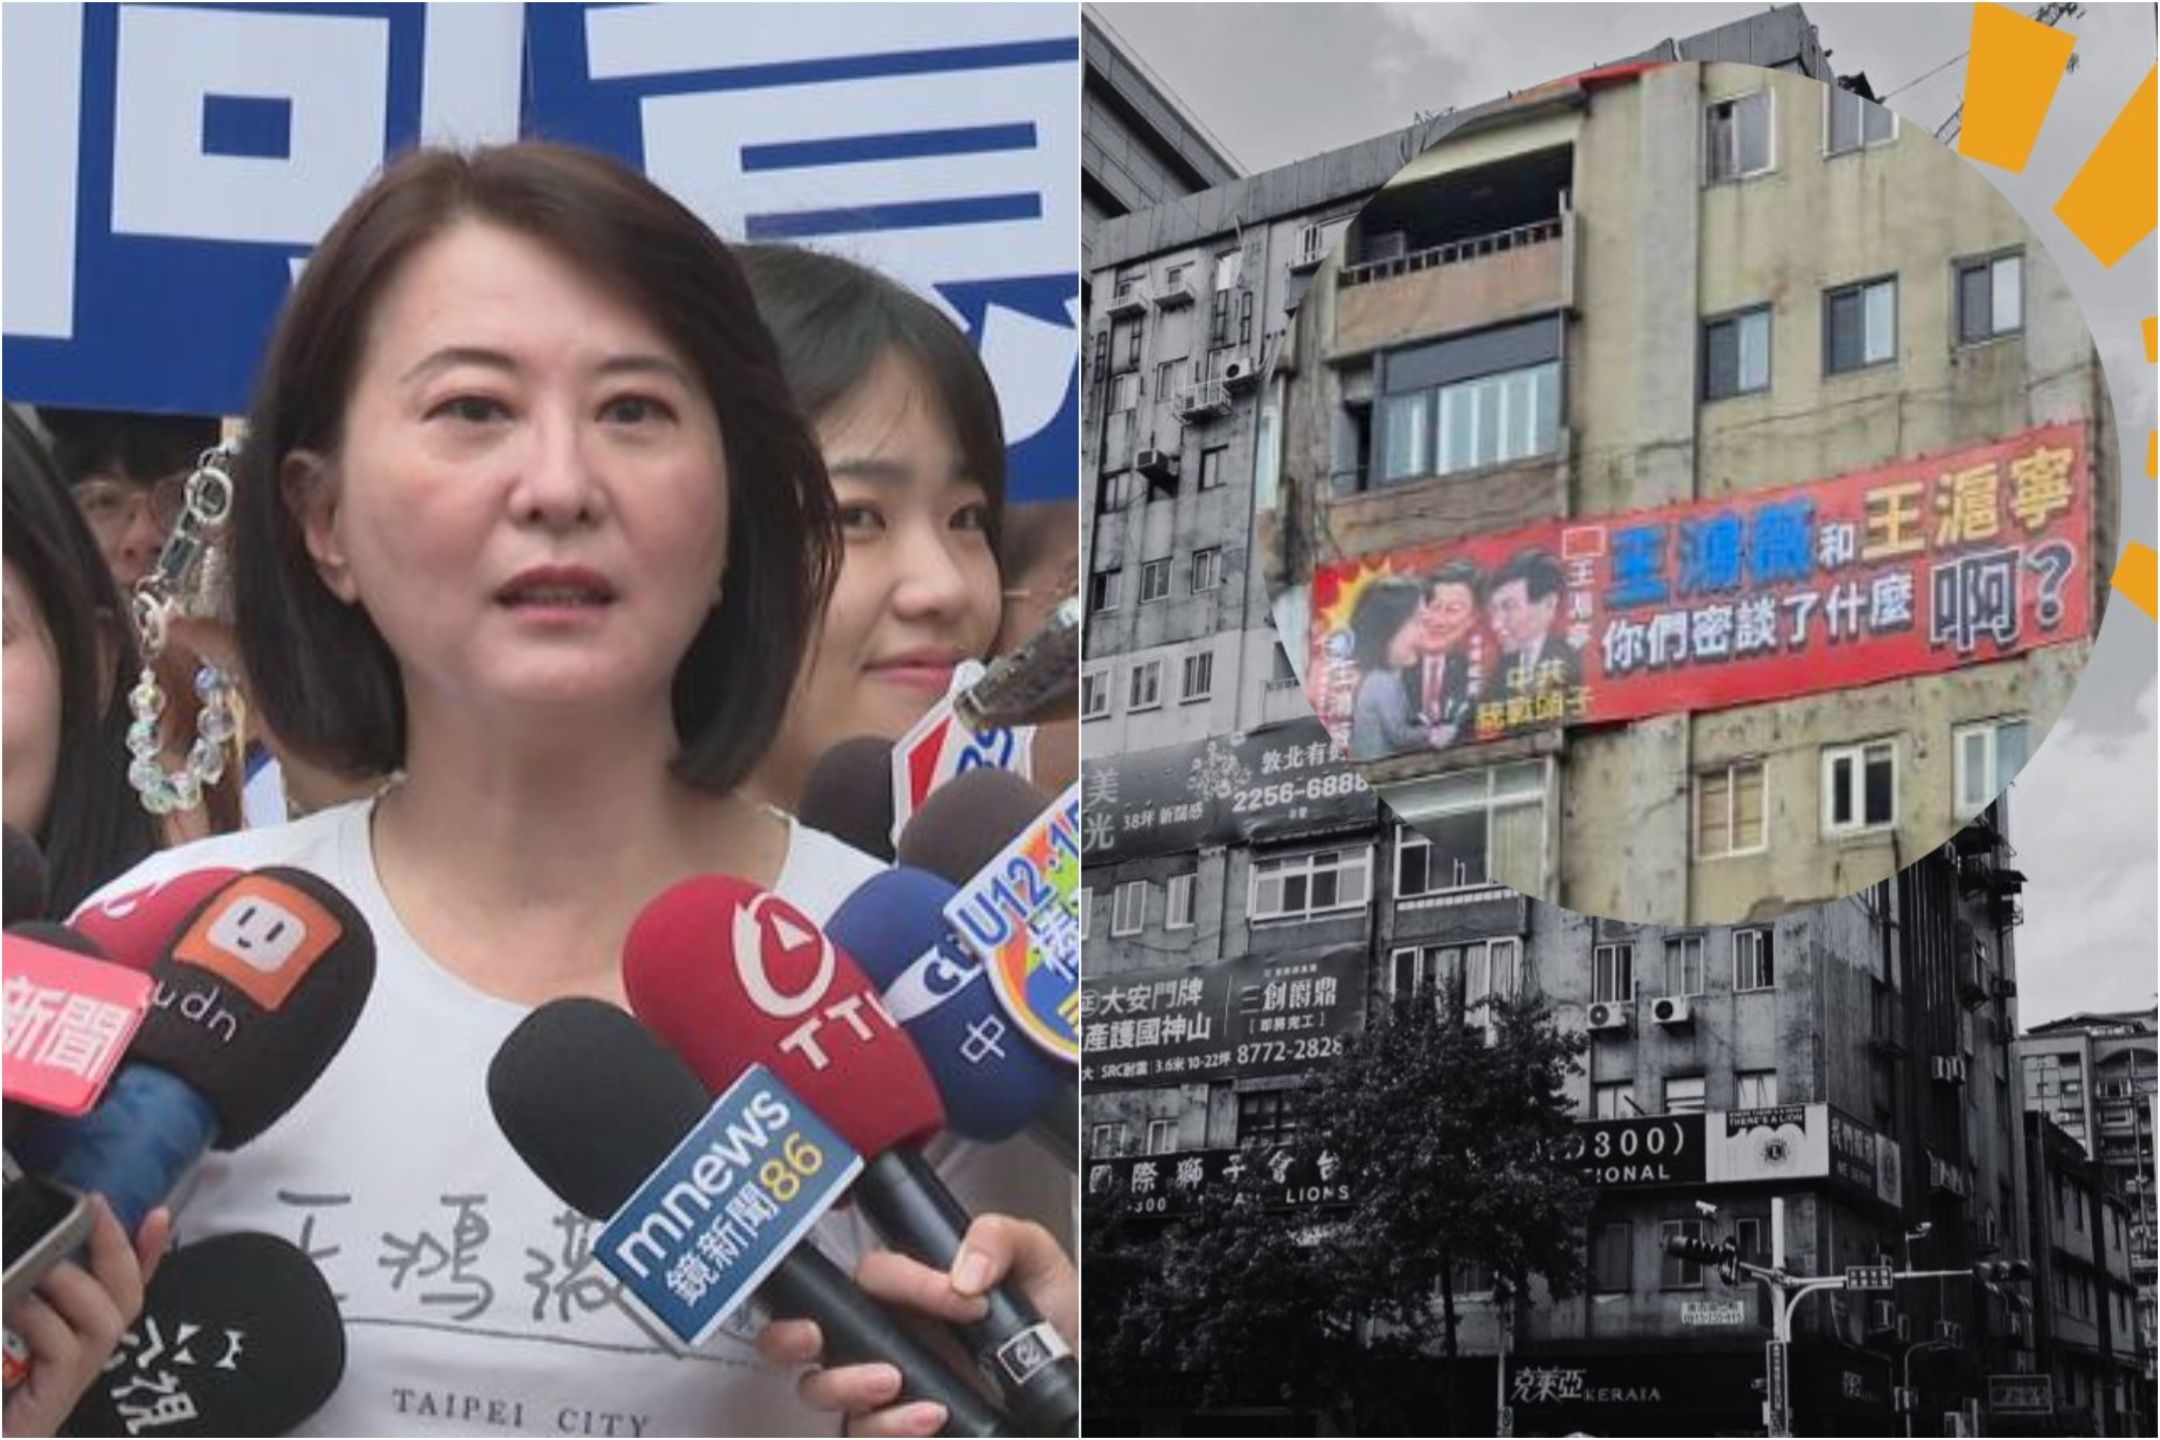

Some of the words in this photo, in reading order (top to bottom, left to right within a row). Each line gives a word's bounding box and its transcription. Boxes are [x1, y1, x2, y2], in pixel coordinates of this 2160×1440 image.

[152, 979, 238, 1043] udn
[616, 1089, 791, 1279] mnews
[392, 1388, 524, 1428] TAIPEI
[557, 1400, 651, 1435] CITY
